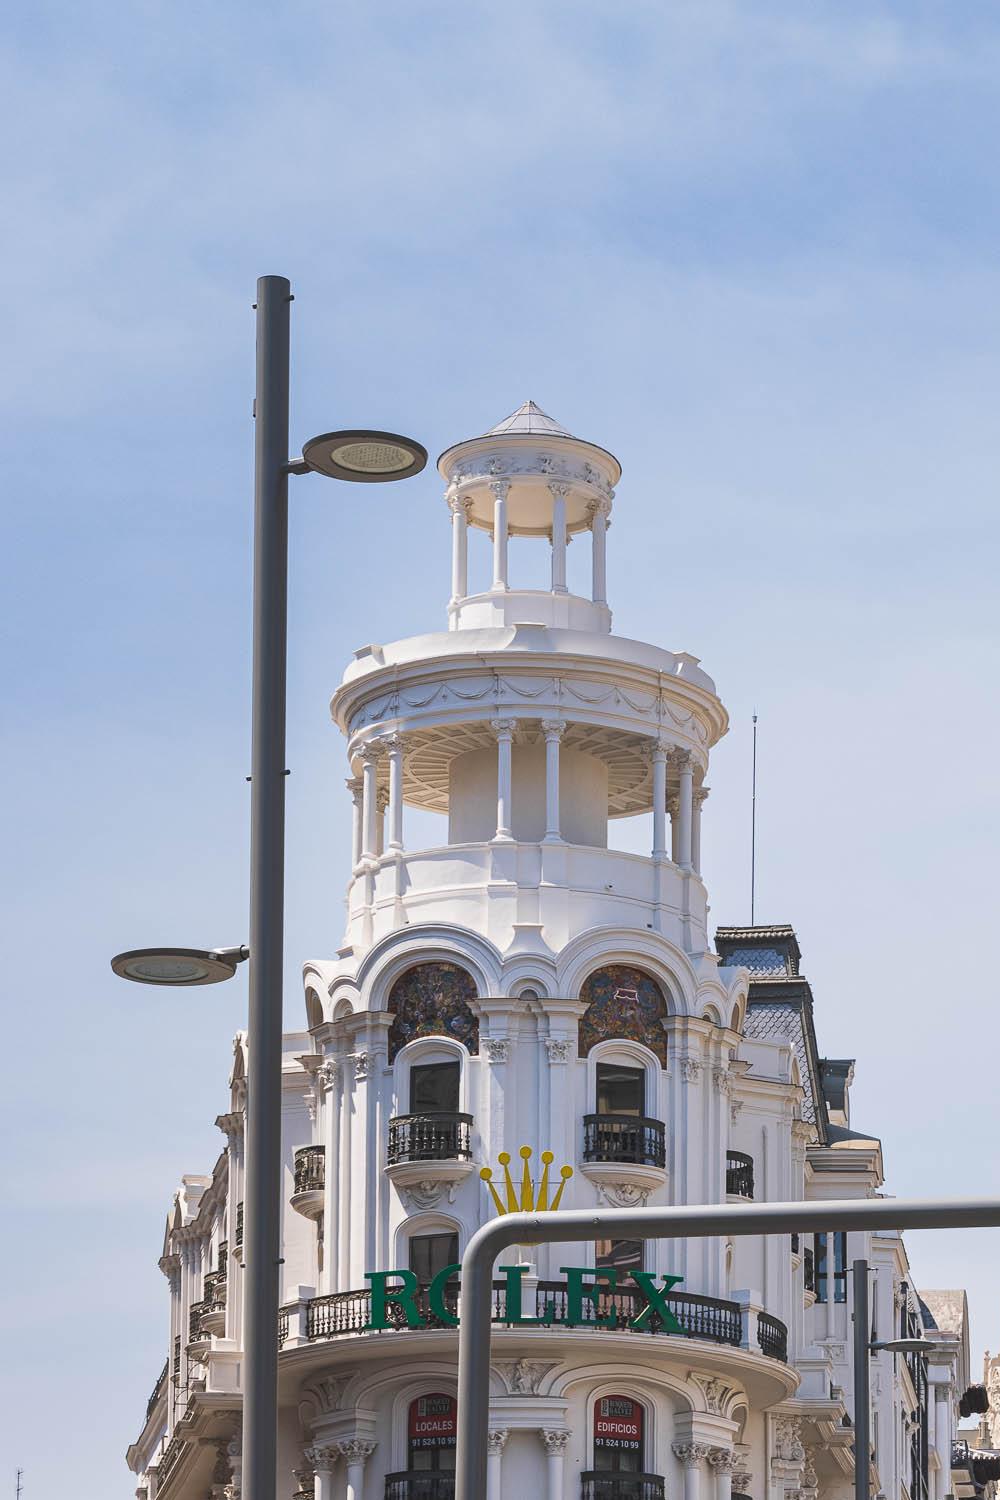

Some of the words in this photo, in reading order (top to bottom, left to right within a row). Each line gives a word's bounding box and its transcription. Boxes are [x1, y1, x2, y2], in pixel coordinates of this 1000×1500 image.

[363, 1263, 688, 1334] ROLEX
[415, 1421, 453, 1432] LOCALES
[597, 1421, 637, 1434] EDIFICIOS
[596, 1438, 604, 1446] 91
[606, 1439, 619, 1447] 524
[620, 1440, 629, 1448] 10
[630, 1441, 639, 1449] 99
